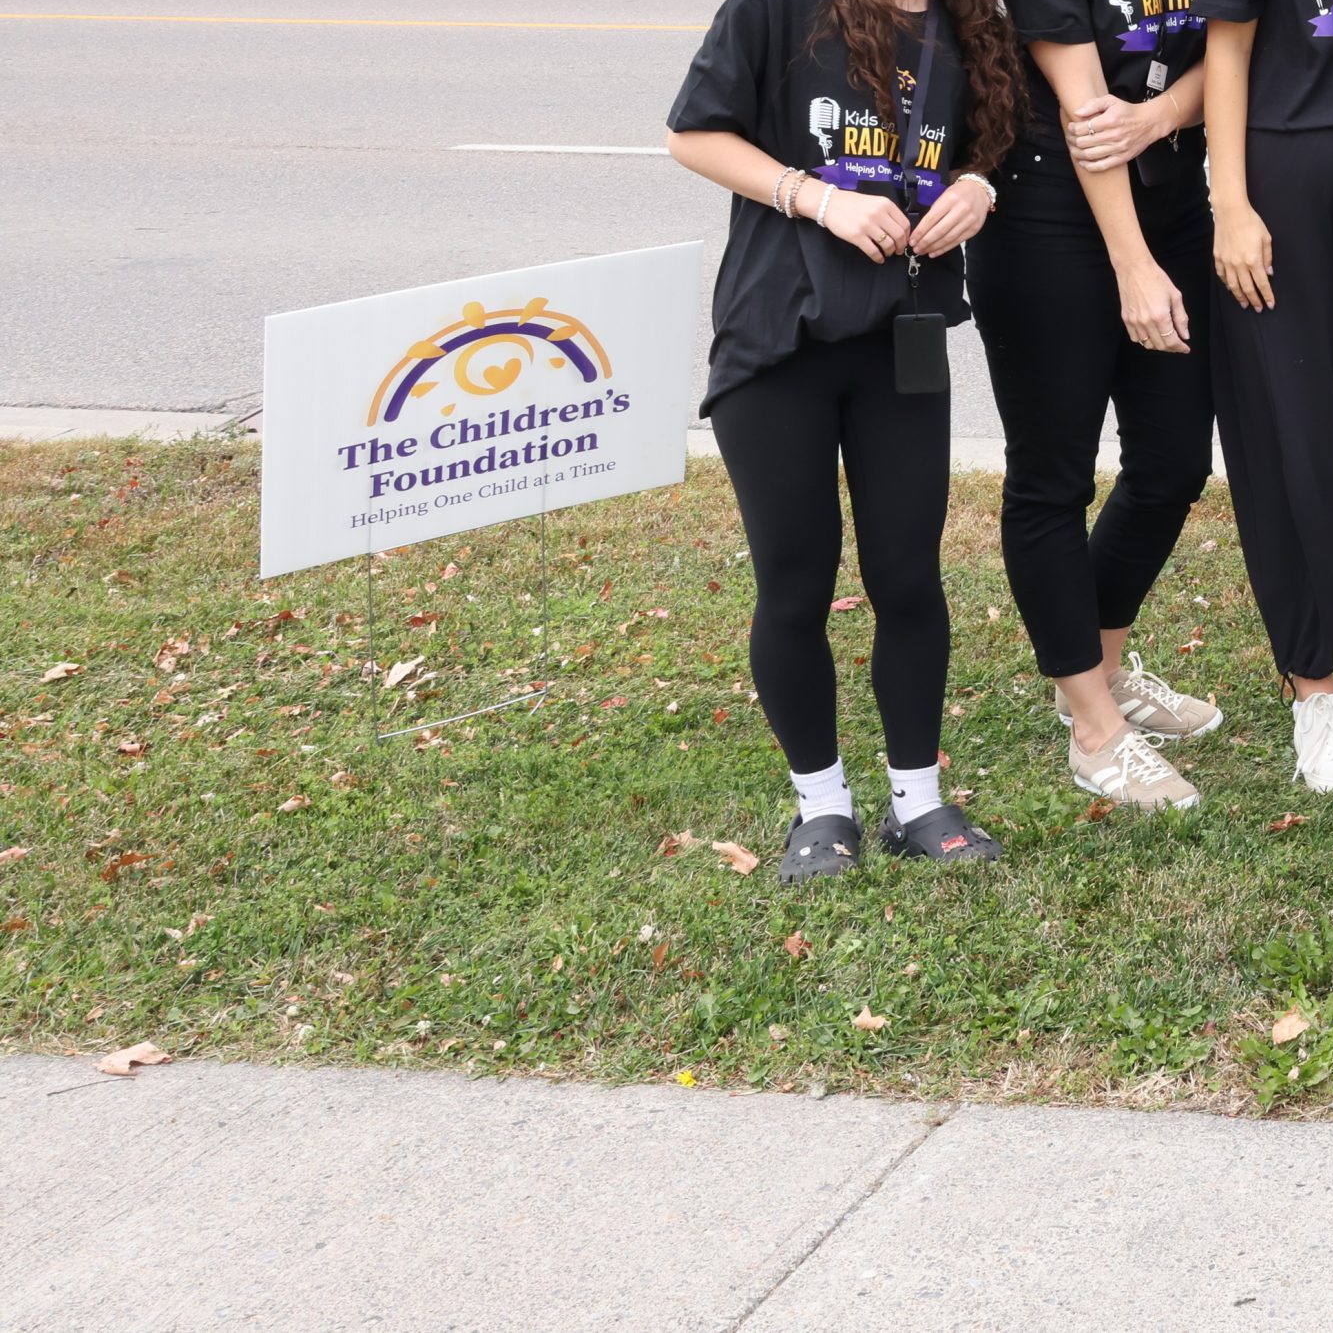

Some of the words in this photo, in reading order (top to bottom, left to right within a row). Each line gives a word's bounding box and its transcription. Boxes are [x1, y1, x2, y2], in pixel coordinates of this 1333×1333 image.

[845, 109, 878, 126] Kids
[845, 162, 876, 177] Helping
[338, 436, 417, 471] The
[429, 389, 631, 450] Children's
[350, 497, 428, 529] Helping
[434, 490, 473, 509] One
[479, 475, 528, 499] Child
[533, 473, 549, 487] at
[555, 472, 565, 483] a
[571, 459, 616, 480] Time
[369, 432, 599, 499] Foundation
